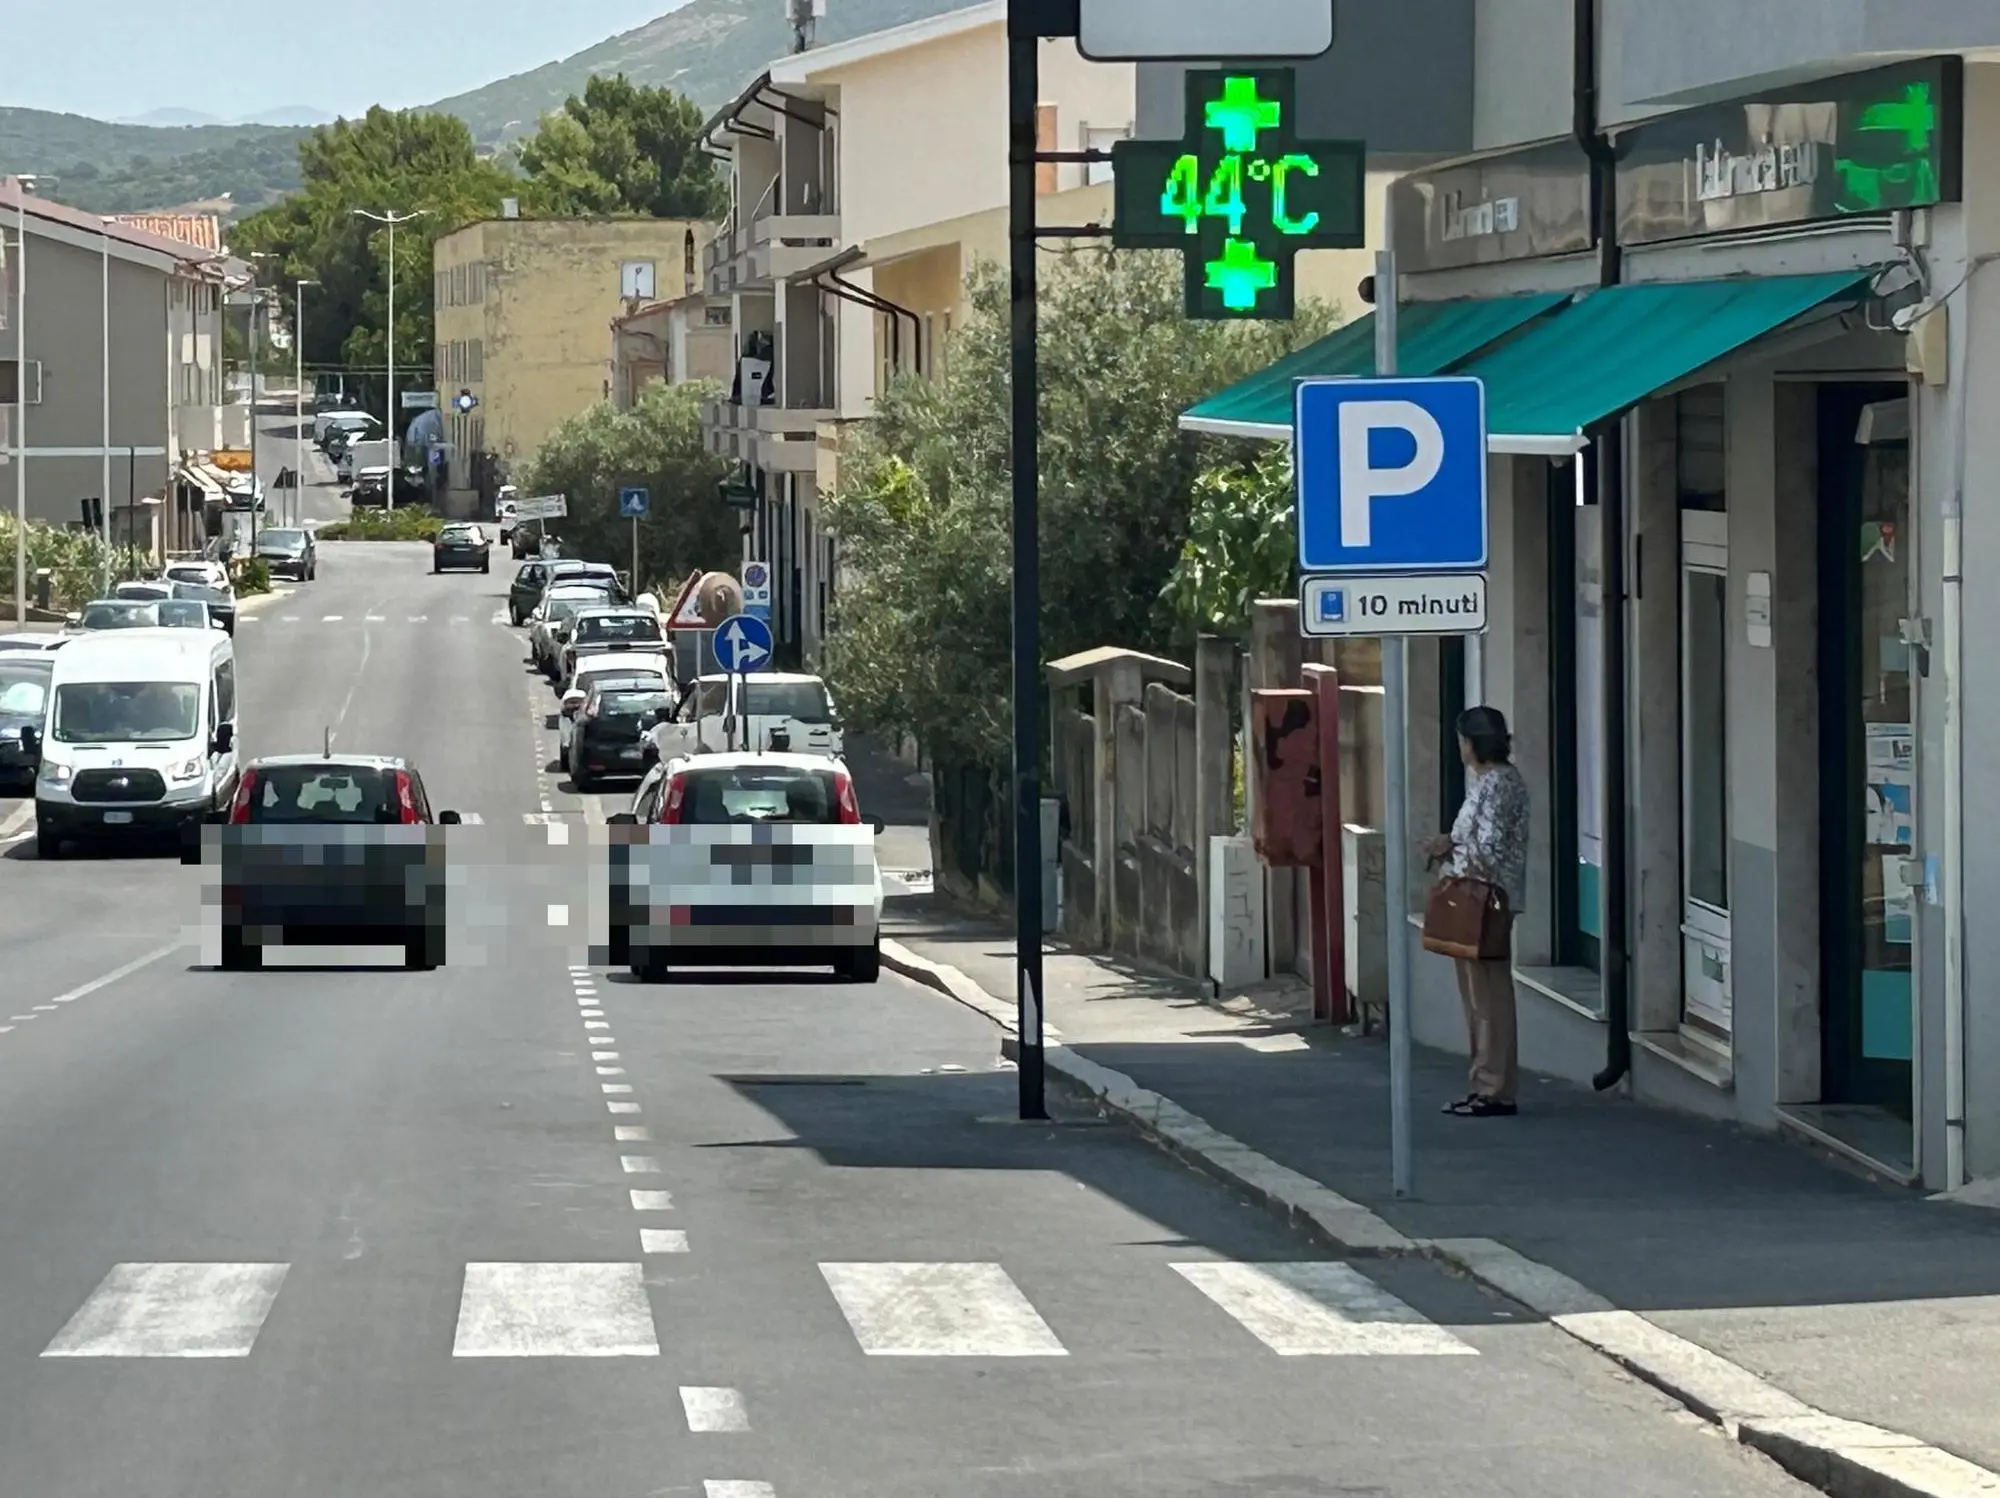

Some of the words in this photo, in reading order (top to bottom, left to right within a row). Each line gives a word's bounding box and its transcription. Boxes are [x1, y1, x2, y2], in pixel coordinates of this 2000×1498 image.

[1160, 154, 1320, 234] 44°C
[1338, 400, 1445, 547] P
[1358, 595, 1388, 616] 10
[1398, 591, 1478, 615] minuti
